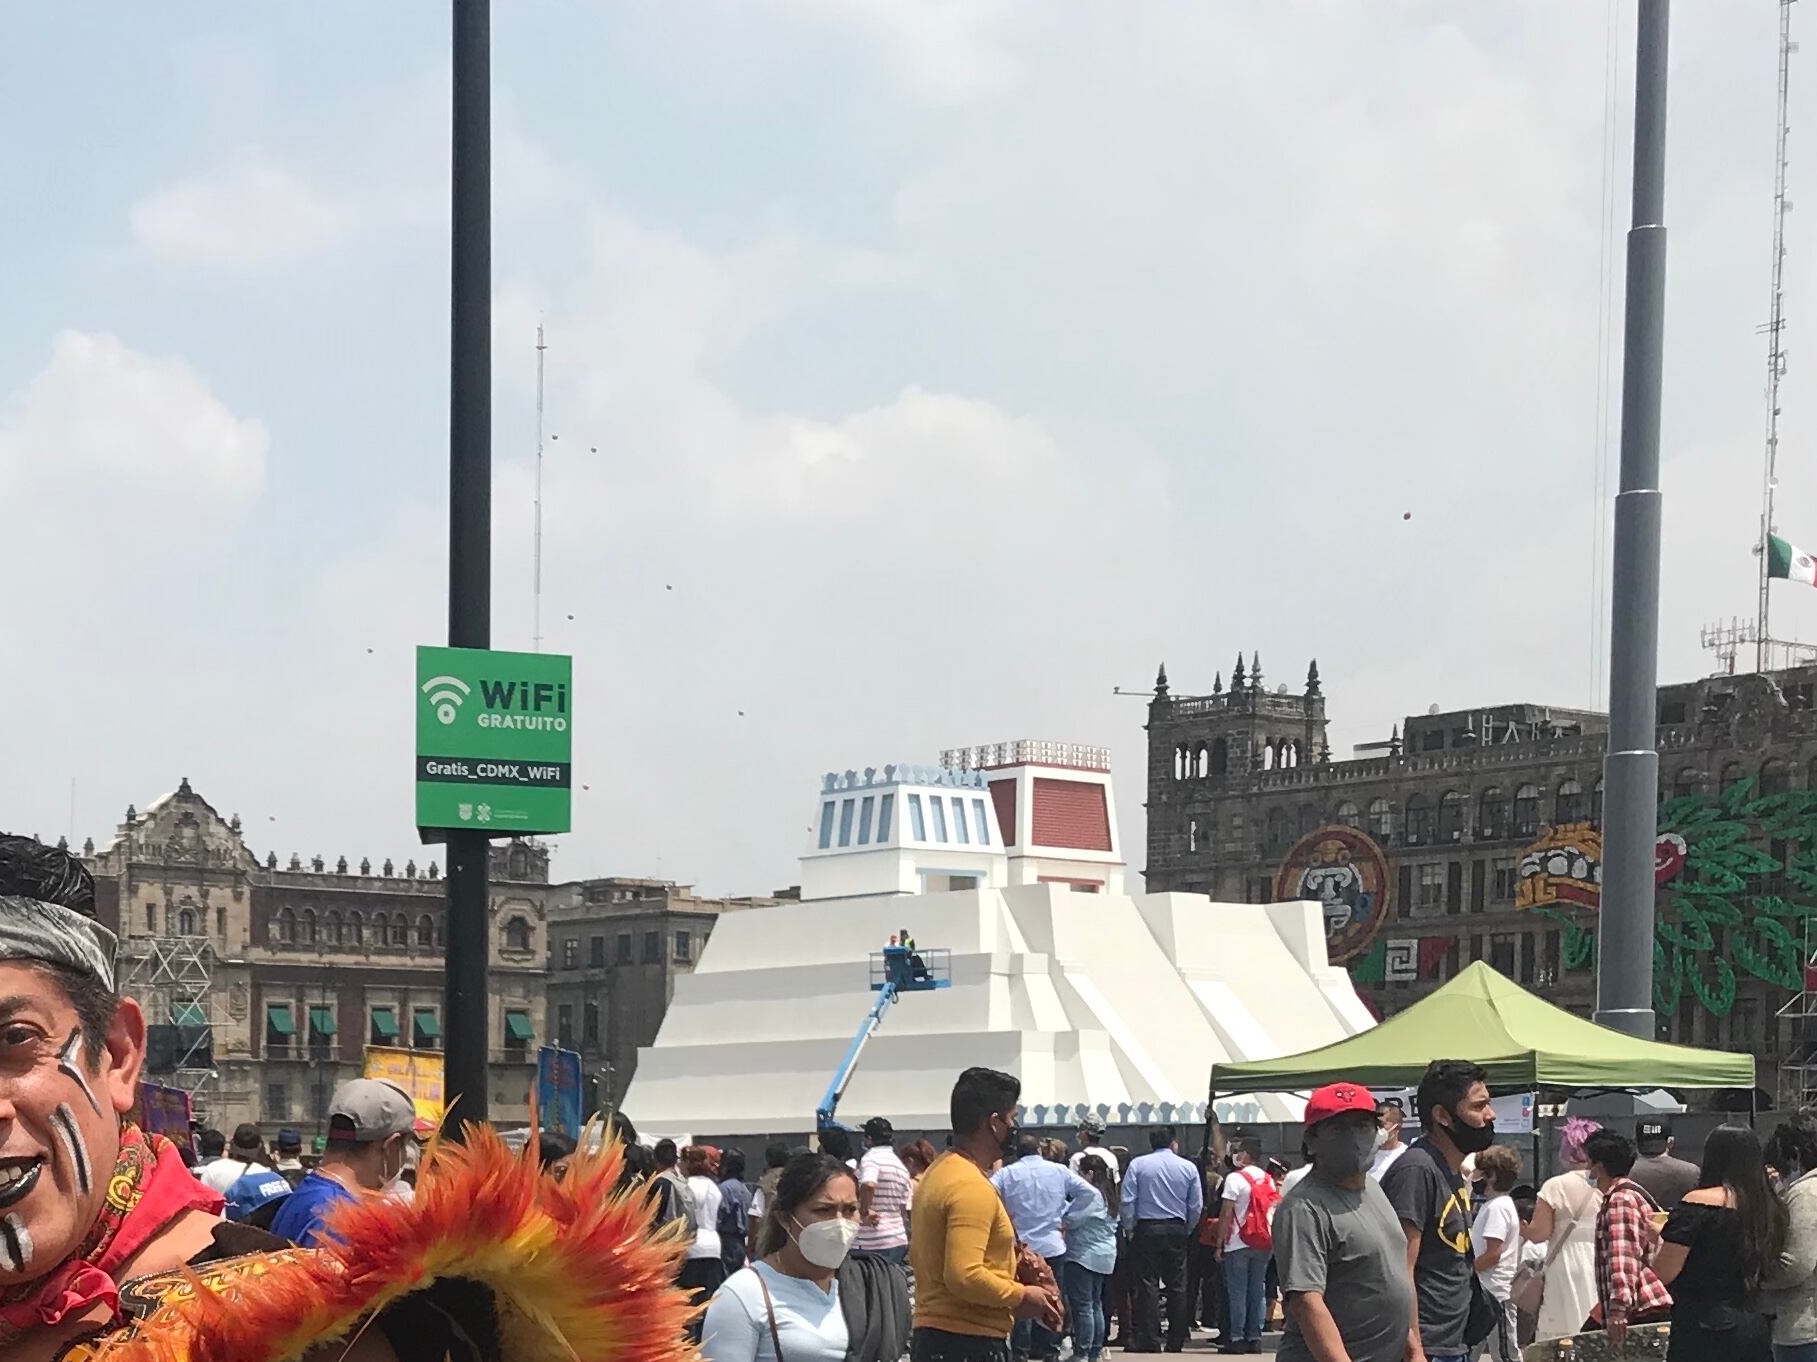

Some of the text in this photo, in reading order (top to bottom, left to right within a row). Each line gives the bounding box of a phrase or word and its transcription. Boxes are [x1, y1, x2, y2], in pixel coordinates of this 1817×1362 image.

[480, 680, 566, 713] WiFi
[477, 714, 567, 731] GRATUITO
[426, 762, 561, 781] Gratis_CDMX_WiFi
